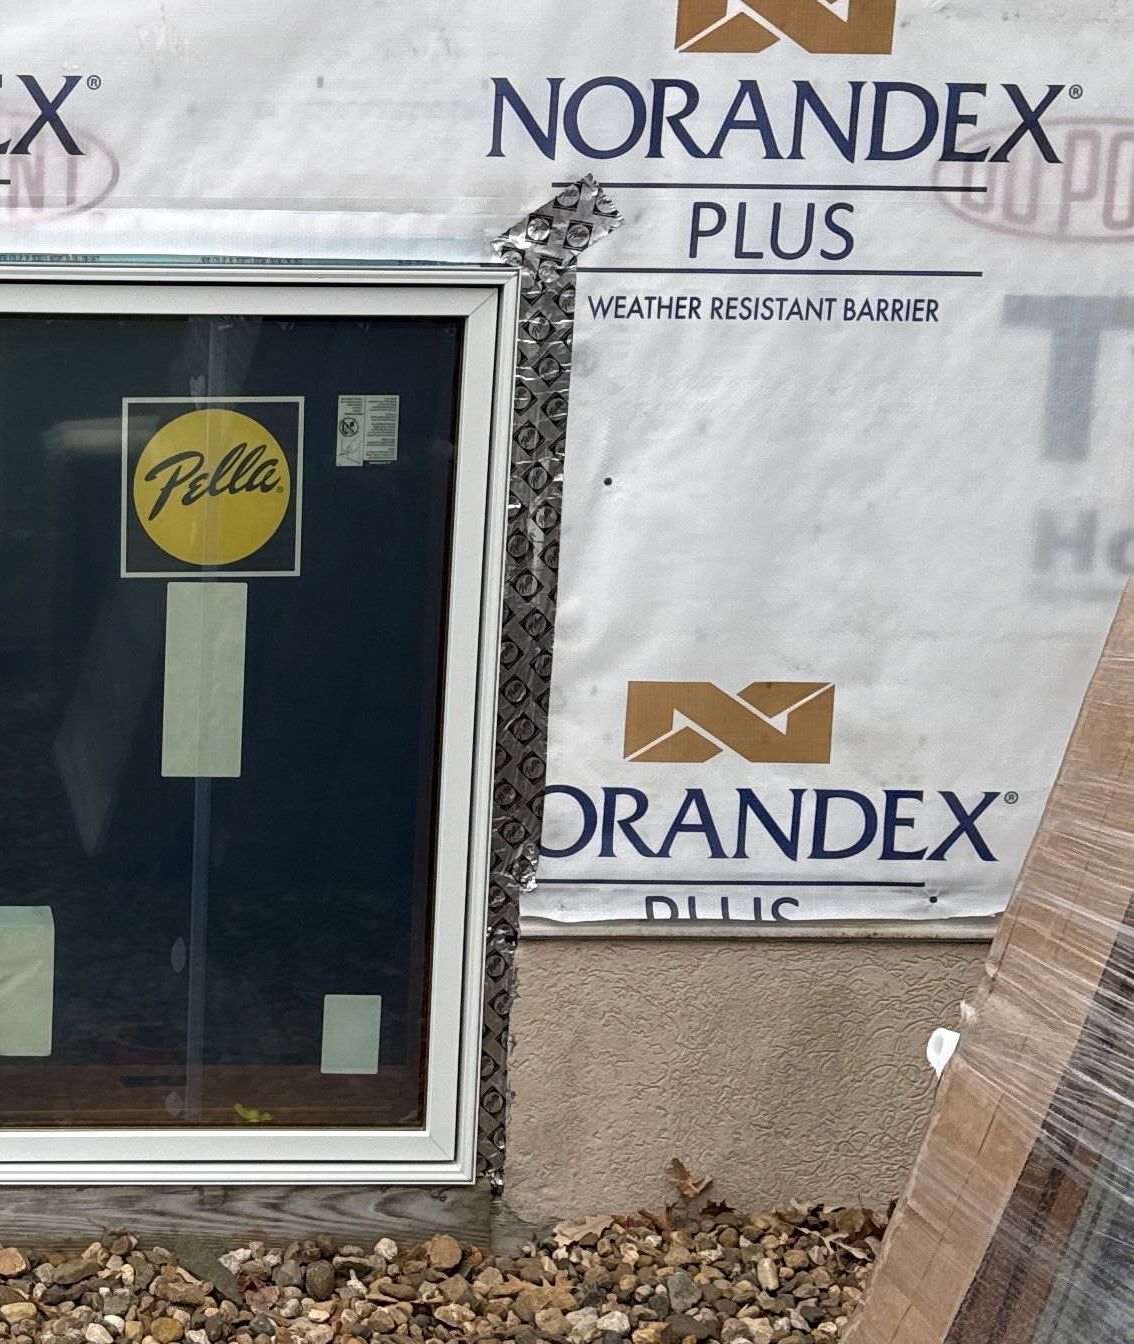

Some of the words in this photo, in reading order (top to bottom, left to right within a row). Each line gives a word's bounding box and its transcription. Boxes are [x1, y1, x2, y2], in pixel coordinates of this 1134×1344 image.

[485, 75, 1084, 164] NORANDEX®
[688, 200, 856, 262] PLUS
[587, 295, 702, 321] WEATHER
[710, 296, 838, 323] RESISTANT
[842, 297, 940, 324] BARRIER
[144, 442, 282, 521] Pella
[540, 783, 1019, 863] ORANDEX®
